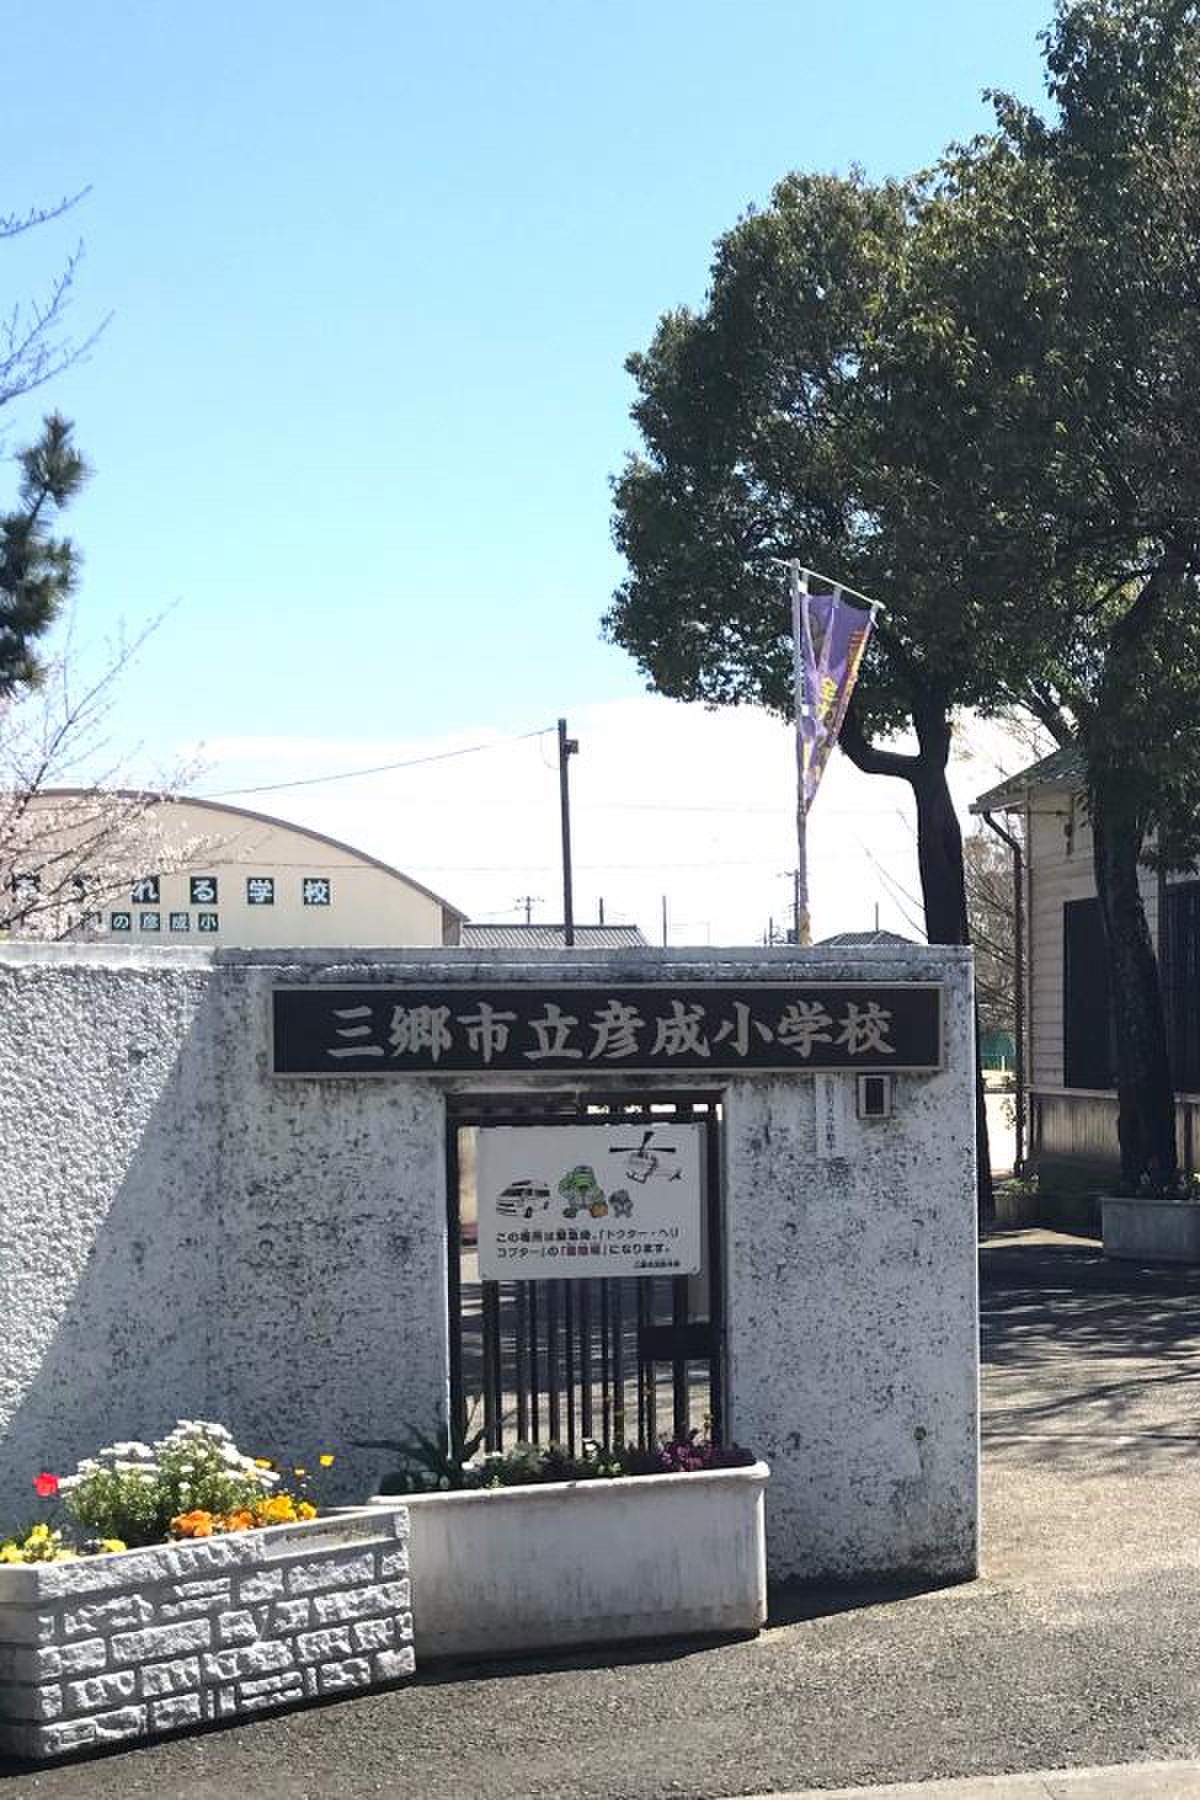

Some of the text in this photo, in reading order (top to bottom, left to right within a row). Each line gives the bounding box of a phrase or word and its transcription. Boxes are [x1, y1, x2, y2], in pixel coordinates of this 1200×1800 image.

[86, 912, 218, 932] の彦成小
[326, 1001, 896, 1063] 三郷市立彦成小学校
